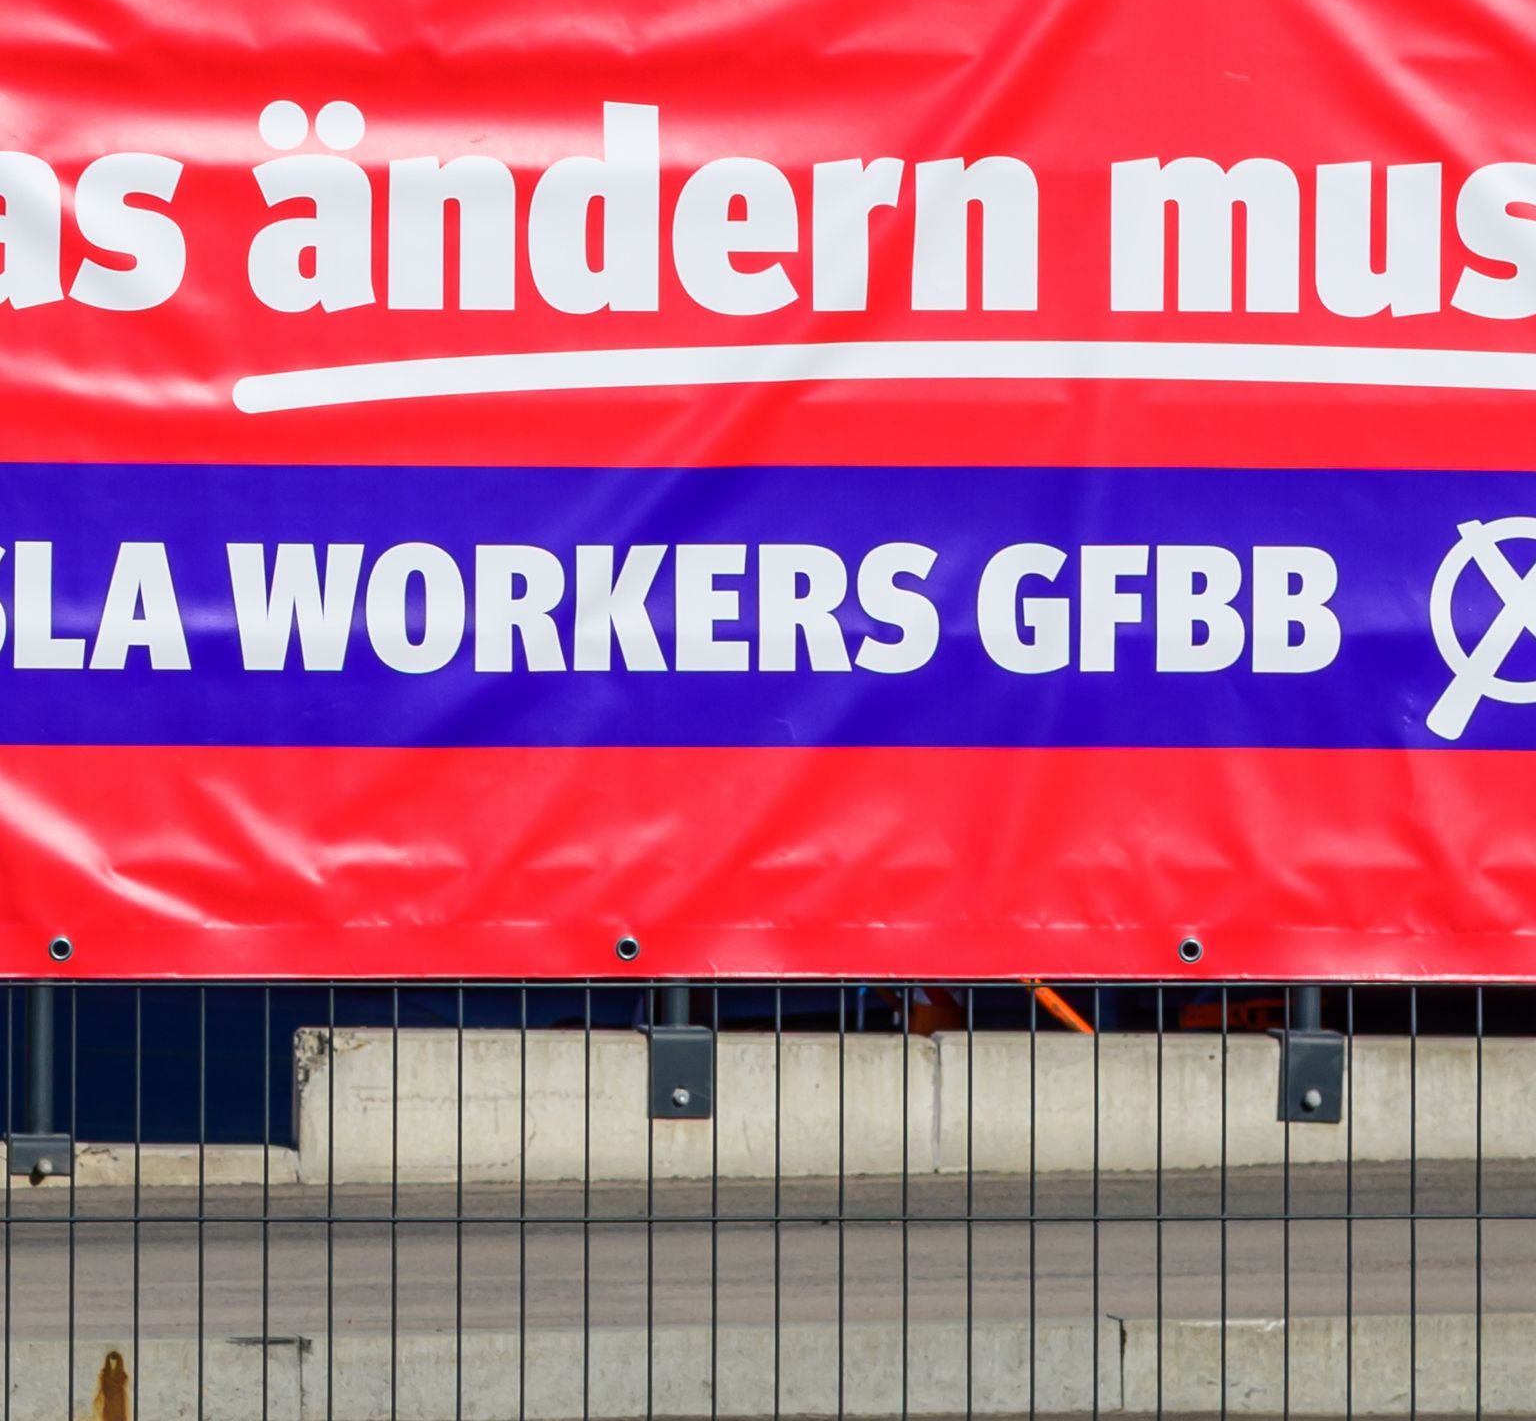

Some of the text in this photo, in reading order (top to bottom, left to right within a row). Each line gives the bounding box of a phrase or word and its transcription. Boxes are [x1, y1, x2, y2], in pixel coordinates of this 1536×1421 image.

[248, 99, 1039, 316] ändern
[226, 541, 940, 675] WORKERS
[976, 541, 1341, 675] GFBB
